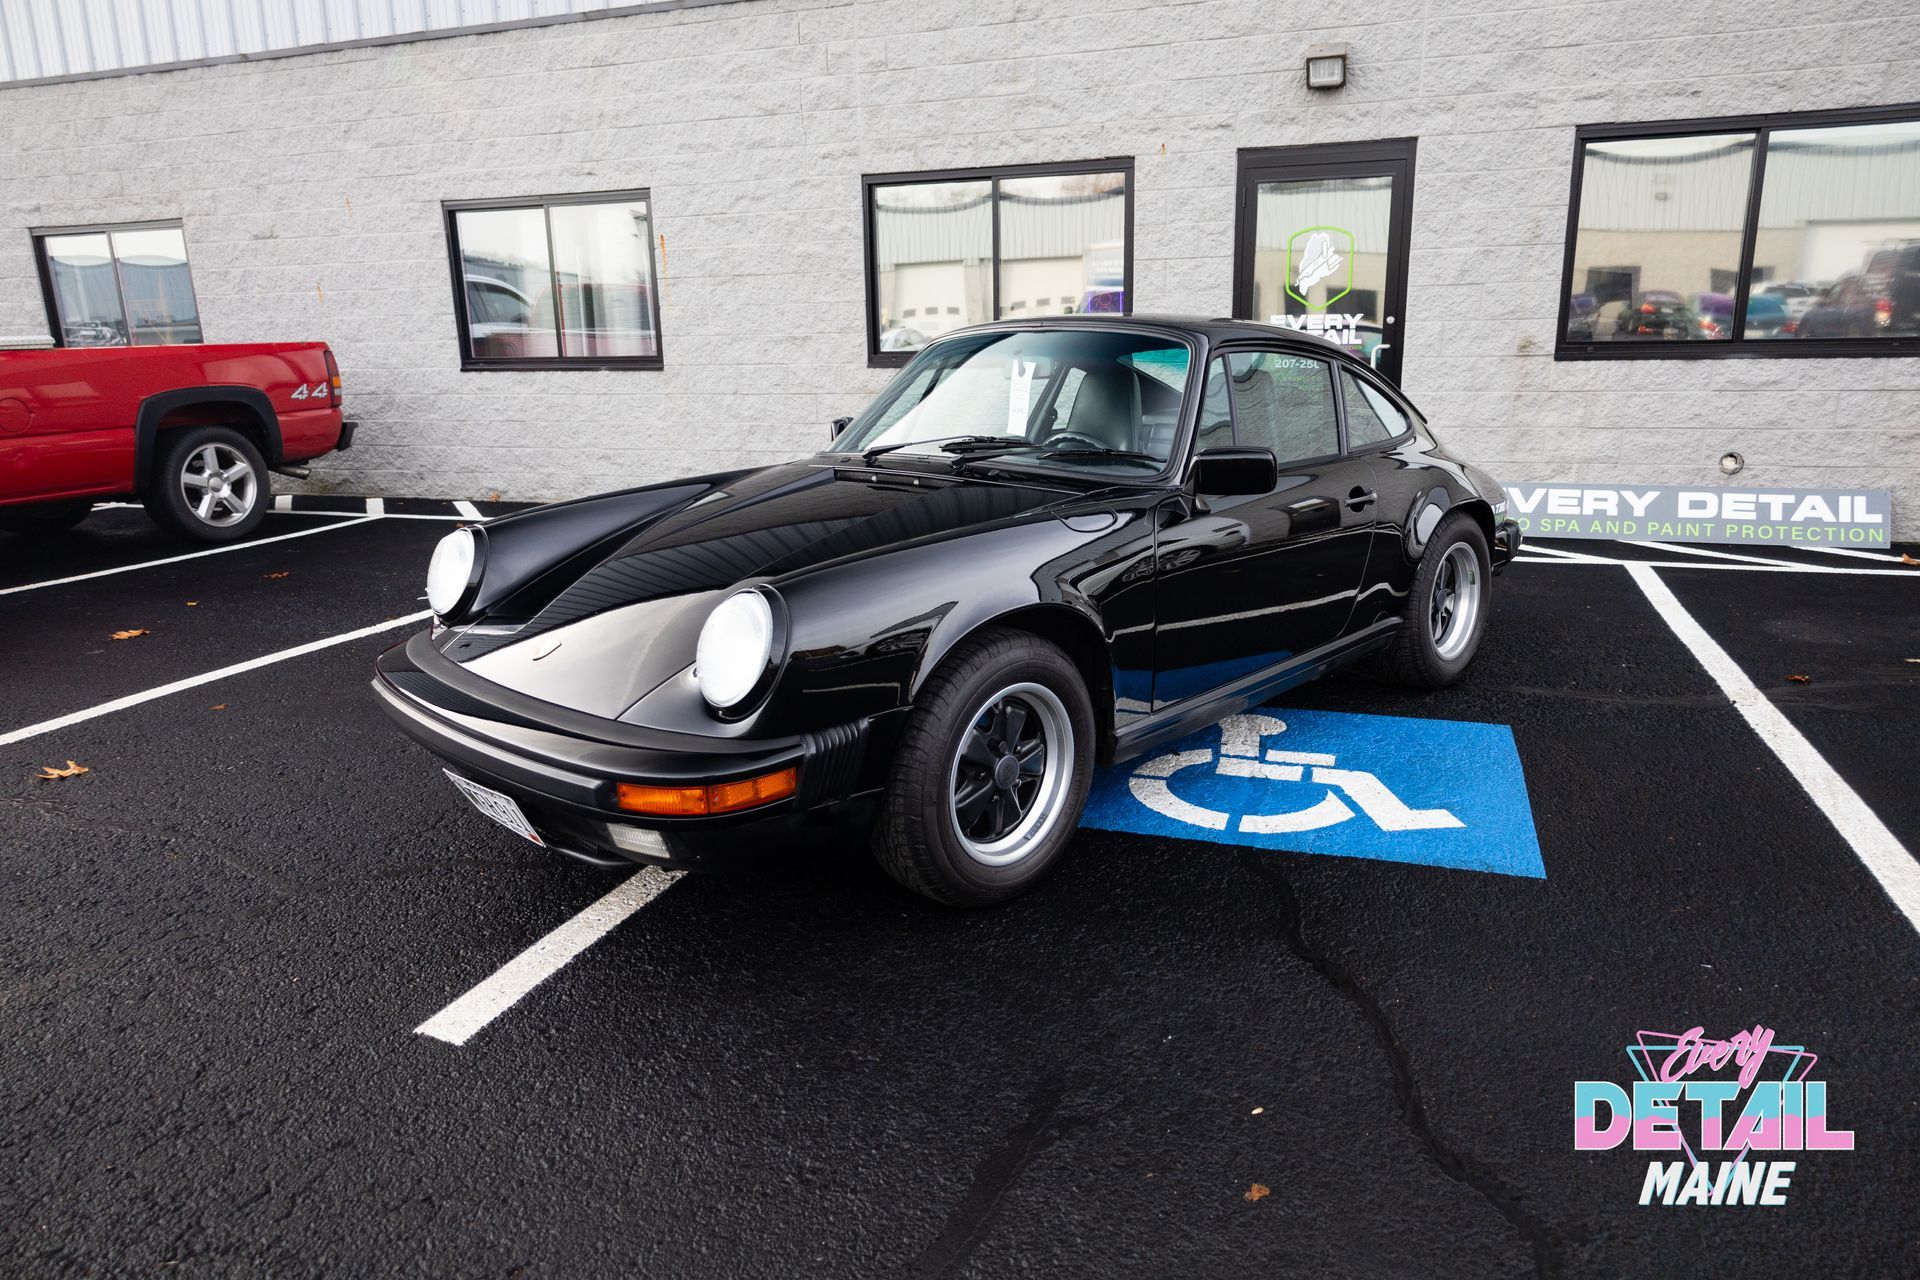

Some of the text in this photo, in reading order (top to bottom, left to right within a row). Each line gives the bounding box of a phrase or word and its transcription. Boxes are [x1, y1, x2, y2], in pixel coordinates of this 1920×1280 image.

[1270, 313, 1364, 330] EVERY
[1502, 487, 1661, 517] VERY
[1677, 491, 1883, 524] DETAIL
[1540, 518, 1581, 533] SPA
[1590, 519, 1638, 535] AND
[1648, 522, 1716, 537] PAINT
[1726, 524, 1884, 543] PROTECTION
